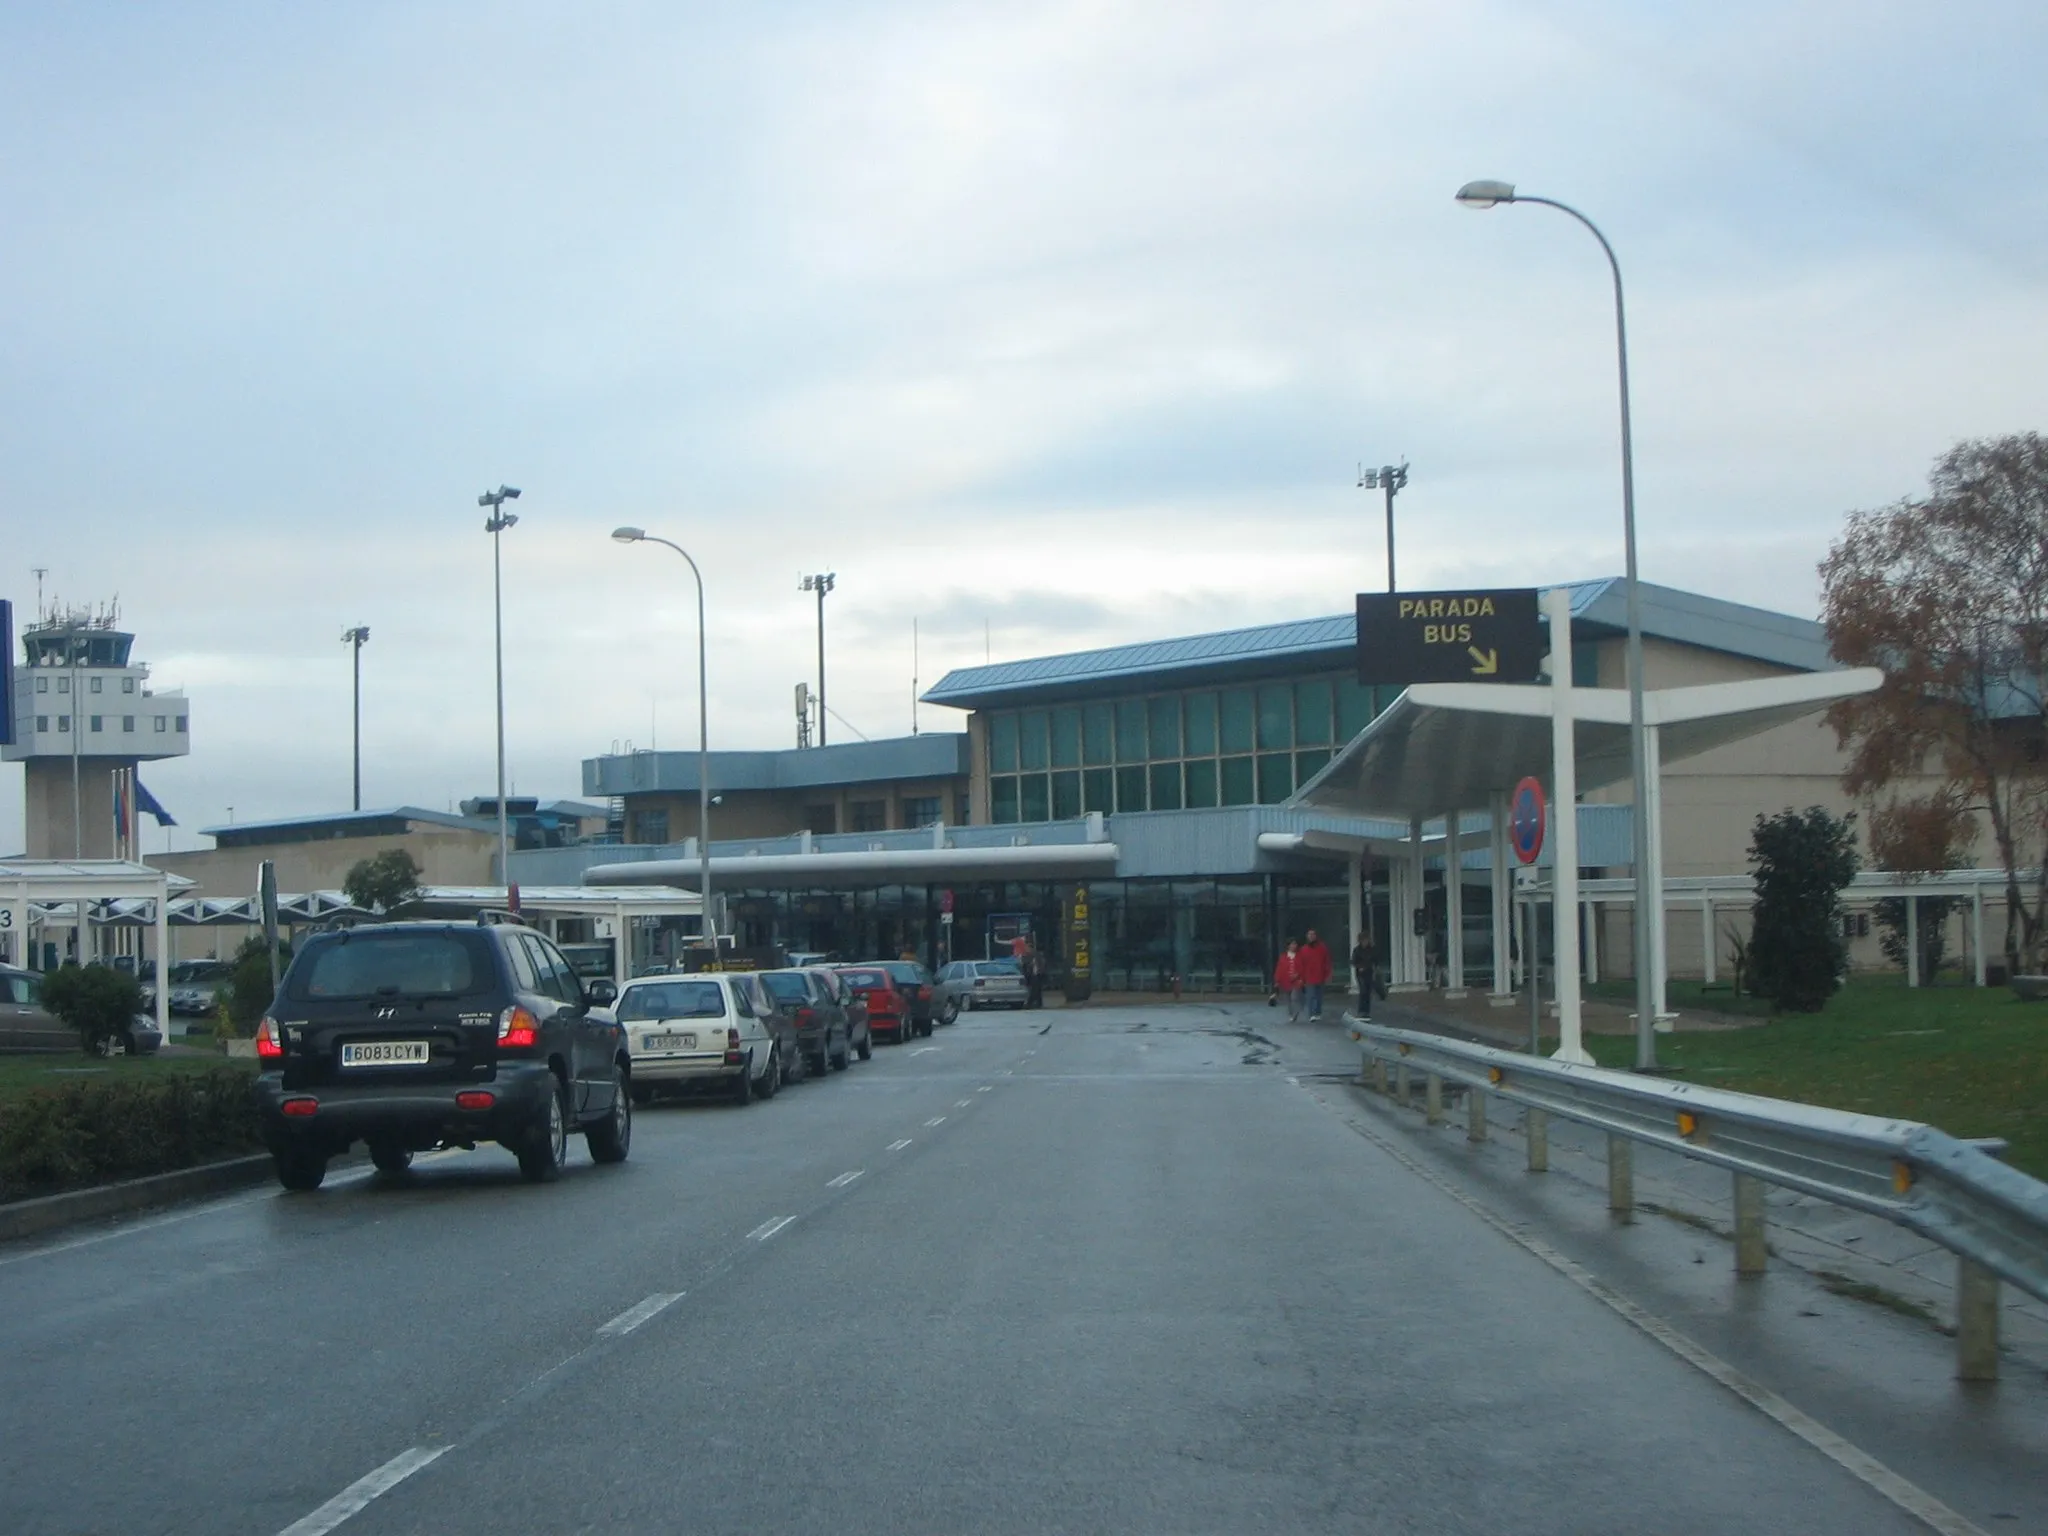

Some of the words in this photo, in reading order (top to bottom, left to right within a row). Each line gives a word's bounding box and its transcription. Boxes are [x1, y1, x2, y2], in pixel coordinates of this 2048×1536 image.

[1399, 597, 1495, 618] PARADA
[1424, 623, 1472, 643] BUS
[0, 909, 12, 928] 3
[354, 1046, 391, 1060] 6083
